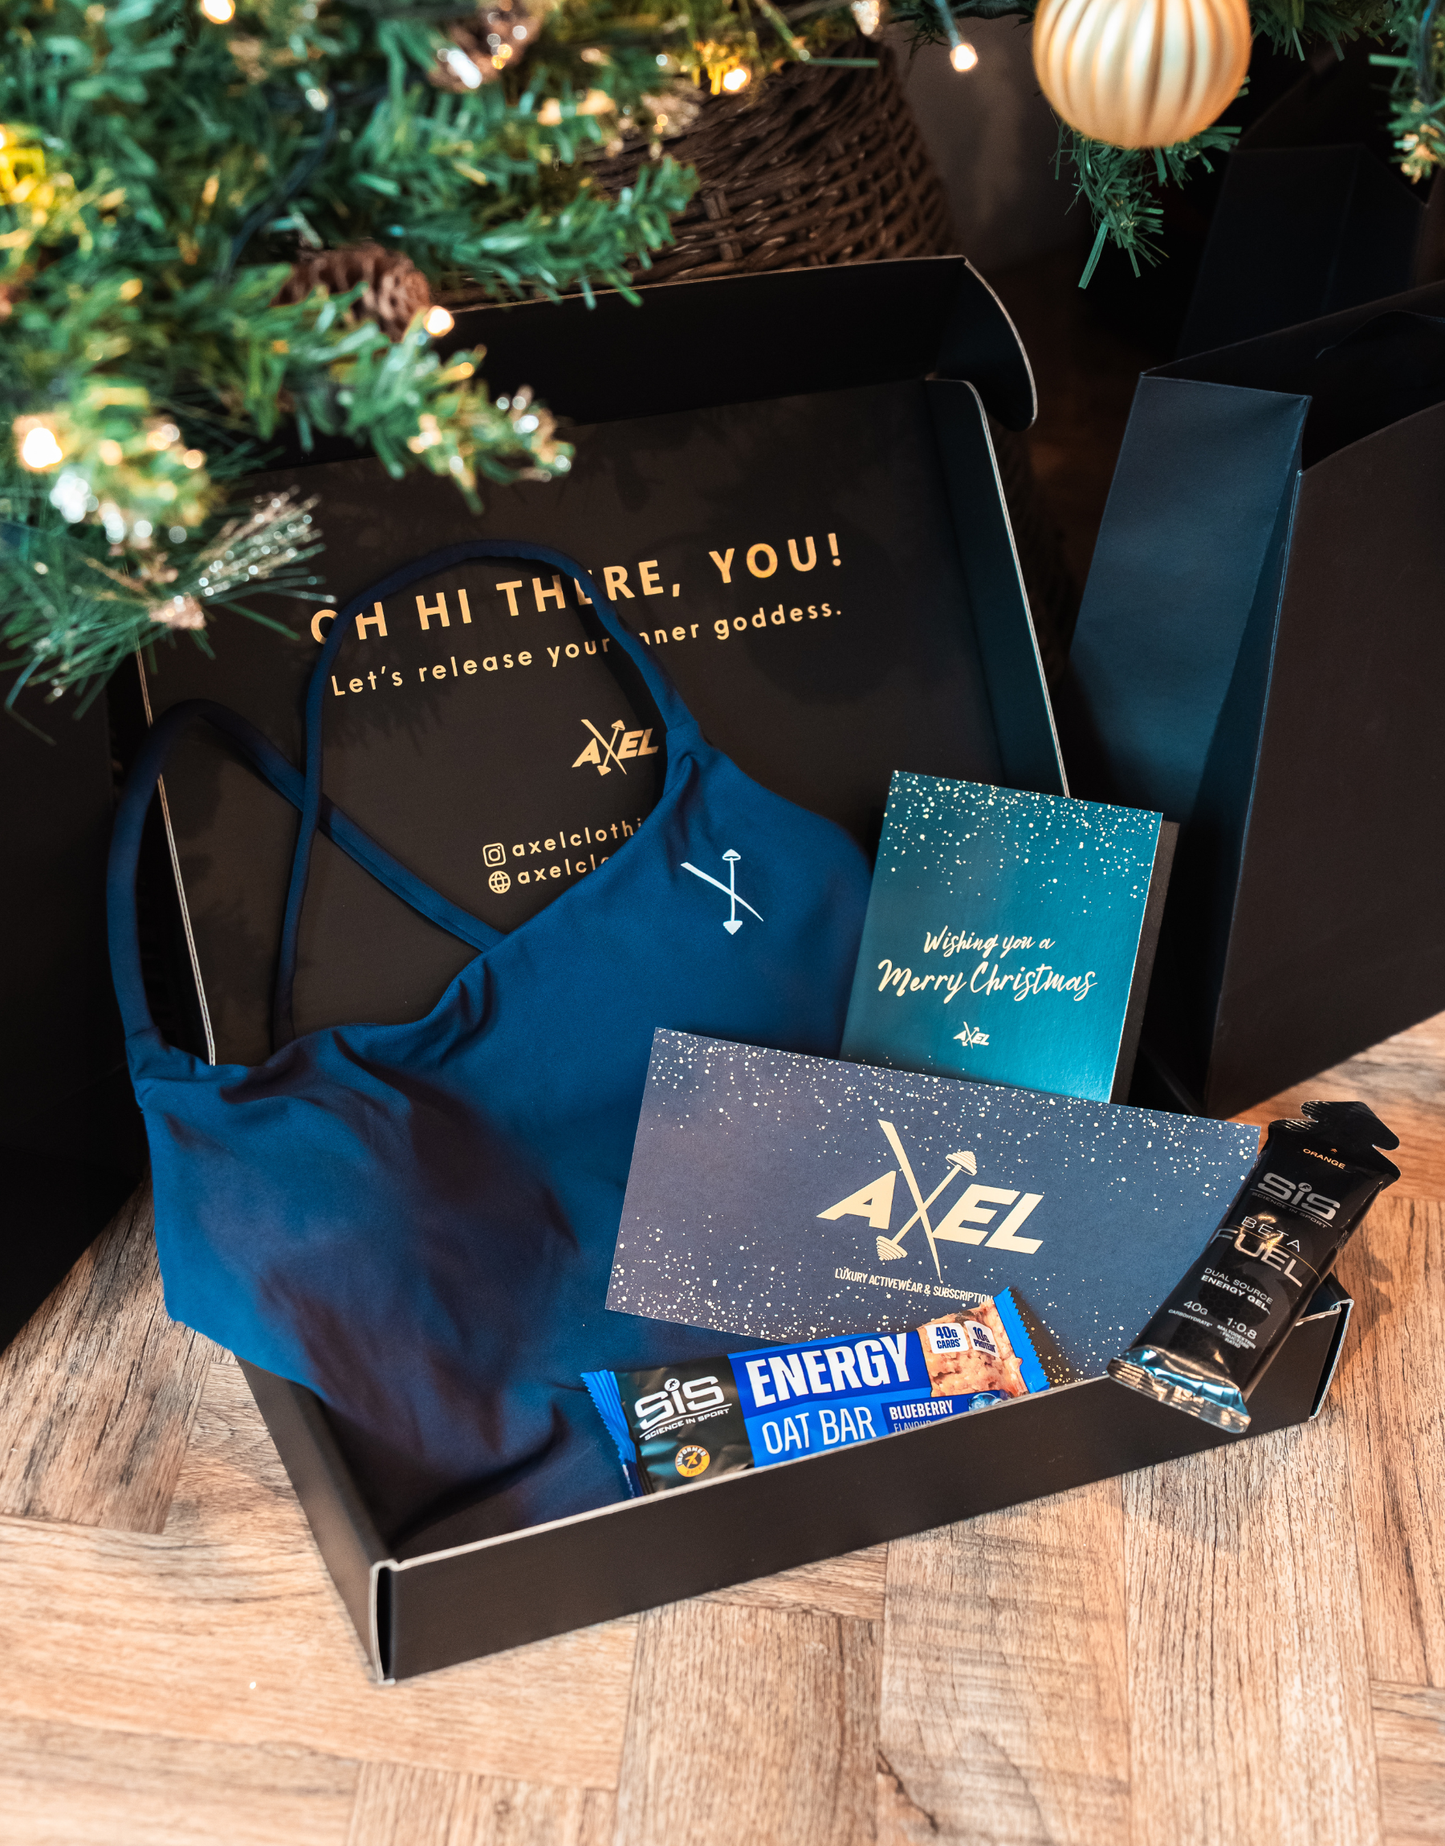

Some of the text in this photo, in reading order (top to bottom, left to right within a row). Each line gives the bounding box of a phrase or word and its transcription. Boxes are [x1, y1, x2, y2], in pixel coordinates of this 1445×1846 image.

[310, 601, 388, 645] OH
[415, 588, 472, 631] HI
[708, 532, 842, 584] YOU!
[331, 665, 403, 697] Let's
[418, 650, 533, 682] release
[546, 637, 610, 668] your
[713, 602, 842, 641] goddess.
[571, 719, 659, 776] AXEL
[923, 925, 1056, 959] Wishing you a
[877, 959, 1098, 1004] Merry Christmas
[1302, 1148, 1346, 1170] ORANGE
[816, 1118, 1045, 1284] AXEL
[1251, 1192, 1288, 1210] SCIENCE
[1299, 1212, 1328, 1229] SPORT
[1241, 1216, 1301, 1253] BETA
[1209, 1228, 1303, 1288] FUEL
[834, 1268, 868, 1284] LUXURY
[868, 1274, 923, 1293] ACTIVEWEAR
[923, 1284, 931, 1294] &
[1200, 1274, 1271, 1316] ENERGY GEL
[1204, 1267, 1274, 1305] DUAL SOURCE
[1183, 1300, 1209, 1316] 40G
[935, 1326, 959, 1339] 40G
[1226, 1317, 1257, 1340] 1:0.8
[744, 1332, 912, 1409] ENERGY
[644, 1408, 729, 1441] SCIENCE IN SPORT
[888, 1399, 953, 1421] BLUEBERRY
[761, 1405, 877, 1455] OAT BAR
[677, 1446, 707, 1466] INFORMED
